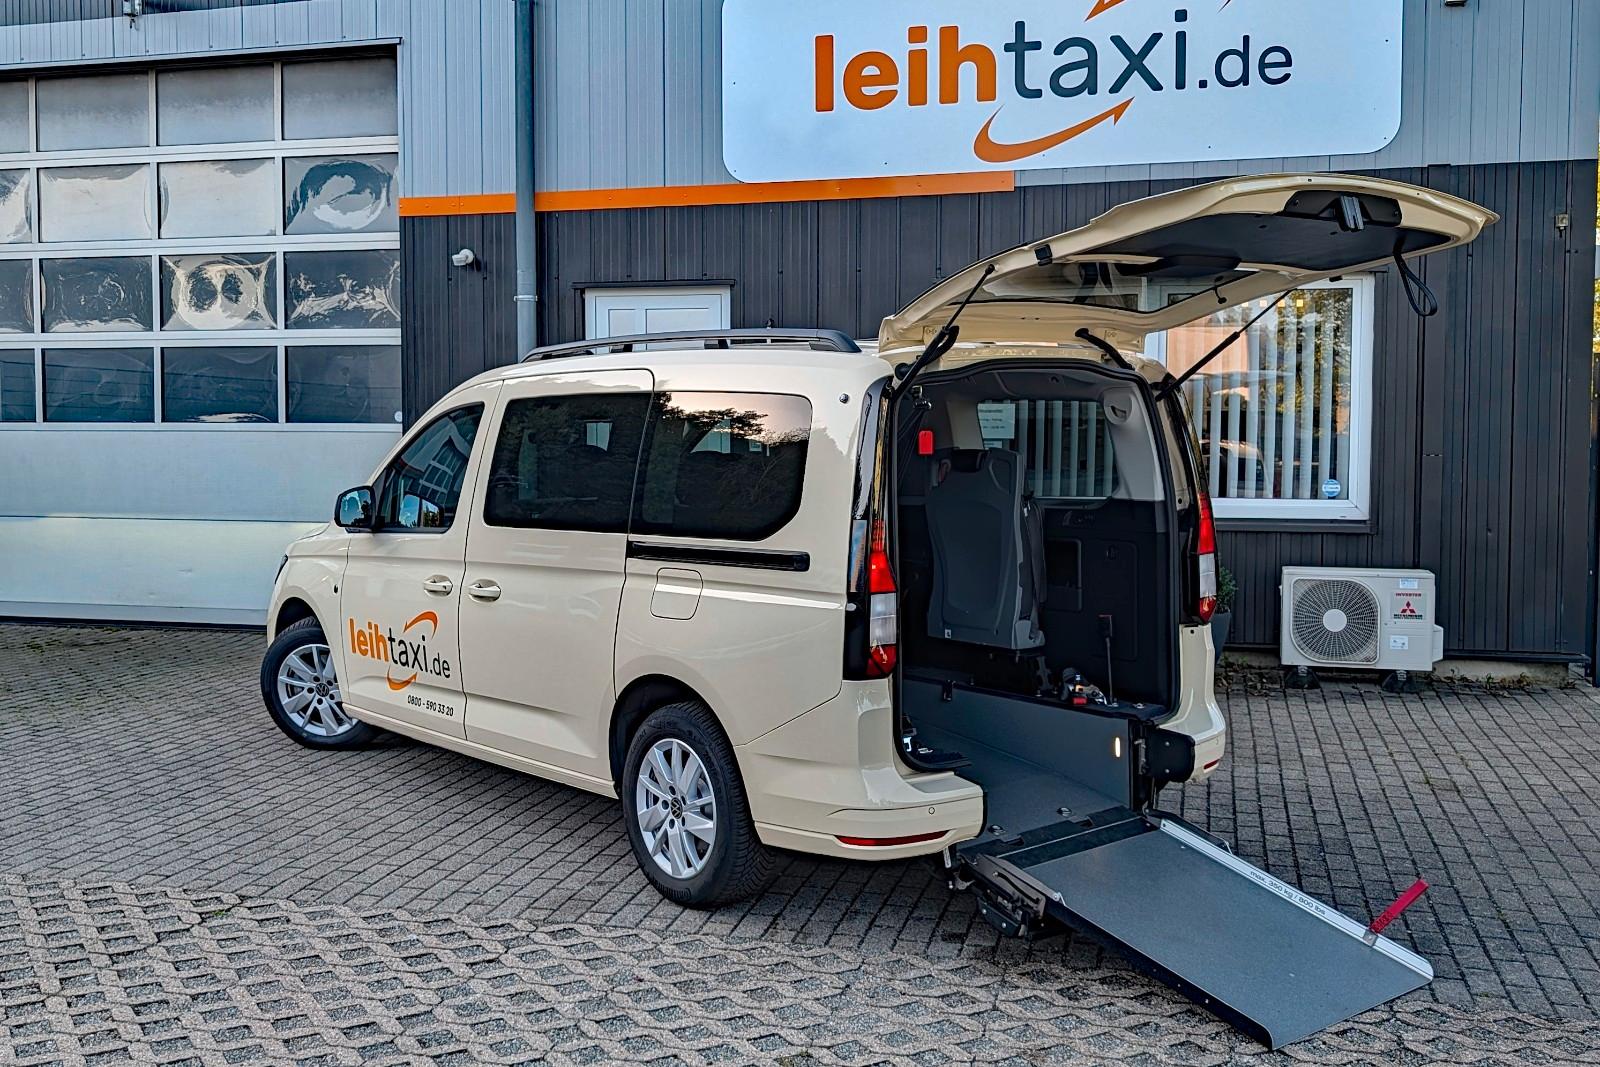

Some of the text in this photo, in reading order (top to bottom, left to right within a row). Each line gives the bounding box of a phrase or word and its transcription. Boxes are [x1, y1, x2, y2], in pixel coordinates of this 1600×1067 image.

[814, 9, 1293, 112] leihtaxi.de
[349, 618, 451, 679] leihtaxi.de
[407, 694, 422, 708] 0800
[426, 700, 437, 712] 590
[437, 703, 446, 715] 33
[445, 706, 454, 718] 20
[1268, 880, 1283, 892] 350
[1283, 887, 1294, 899] kg
[1298, 897, 1314, 909] 800
[1314, 904, 1326, 916] lbs
